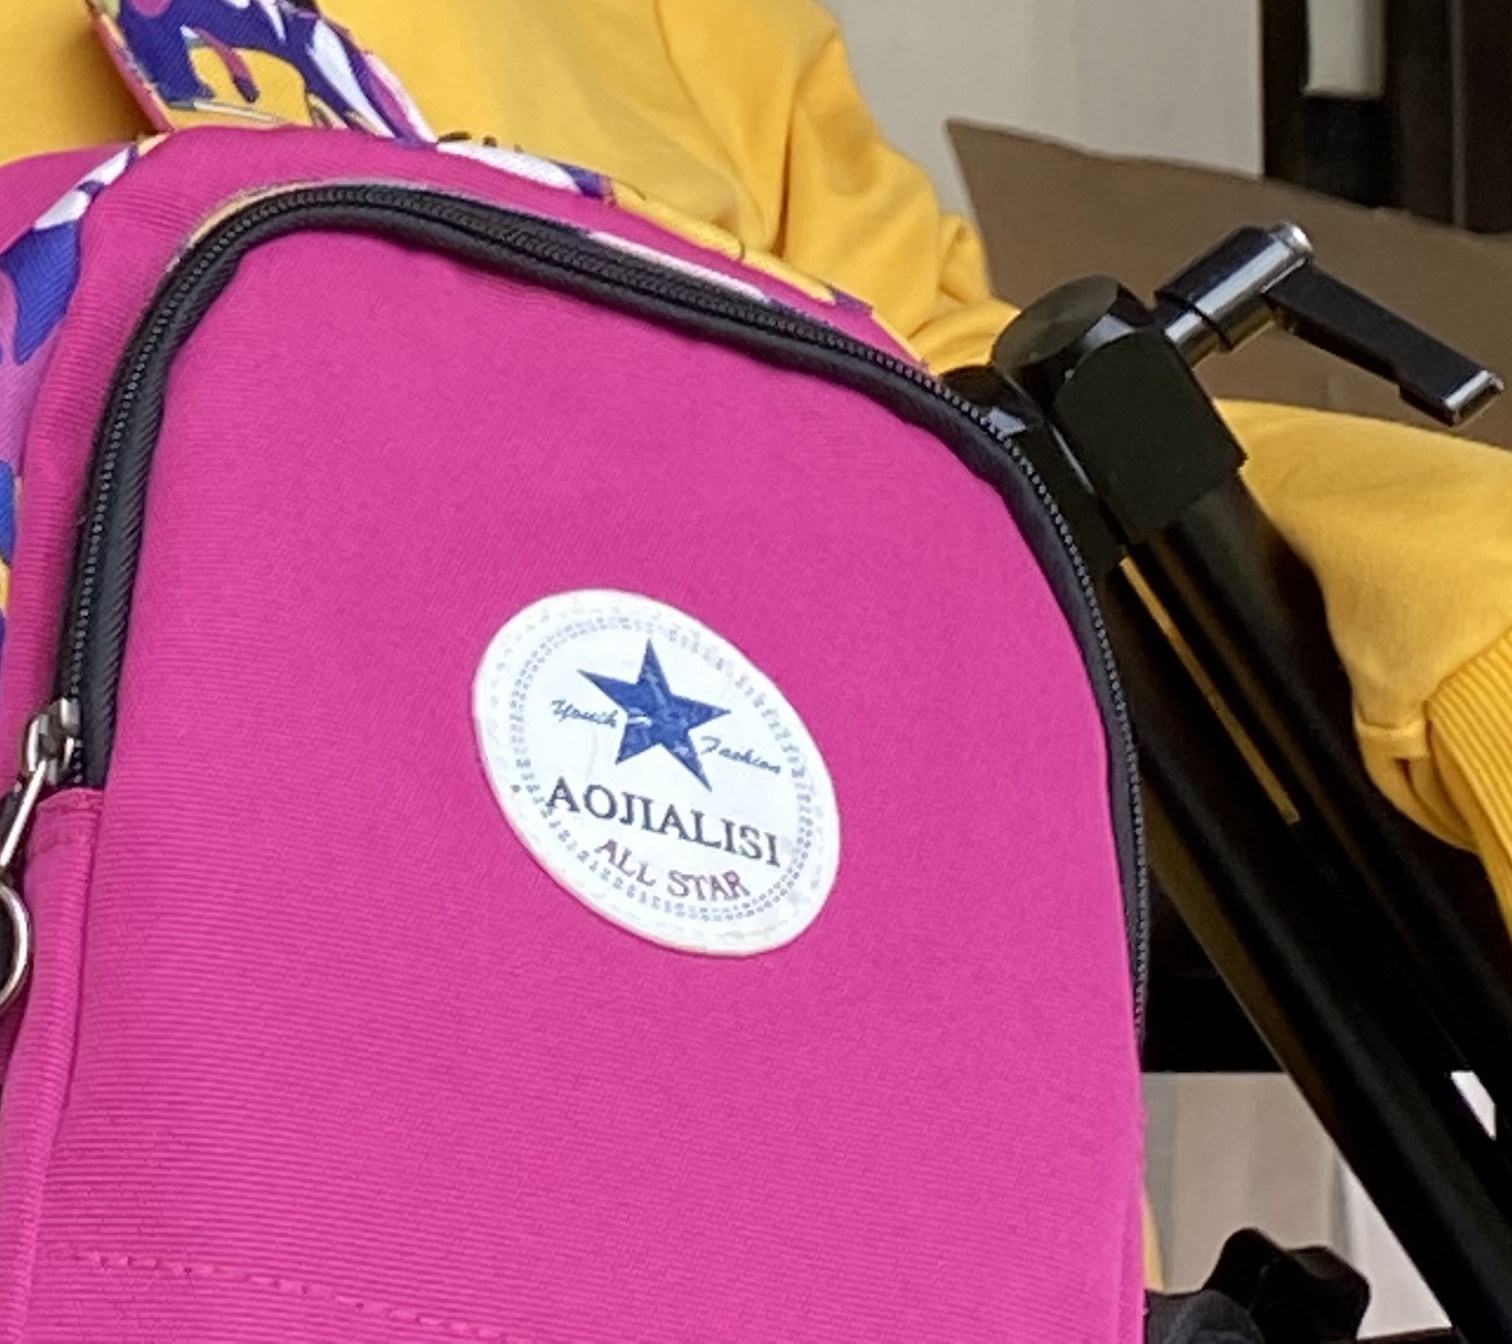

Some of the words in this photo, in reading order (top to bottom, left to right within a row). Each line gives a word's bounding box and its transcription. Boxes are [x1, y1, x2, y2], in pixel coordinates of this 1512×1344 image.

[545, 775, 781, 868] AOJIALISI
[593, 837, 657, 888] ALL
[666, 868, 752, 903] STAR
